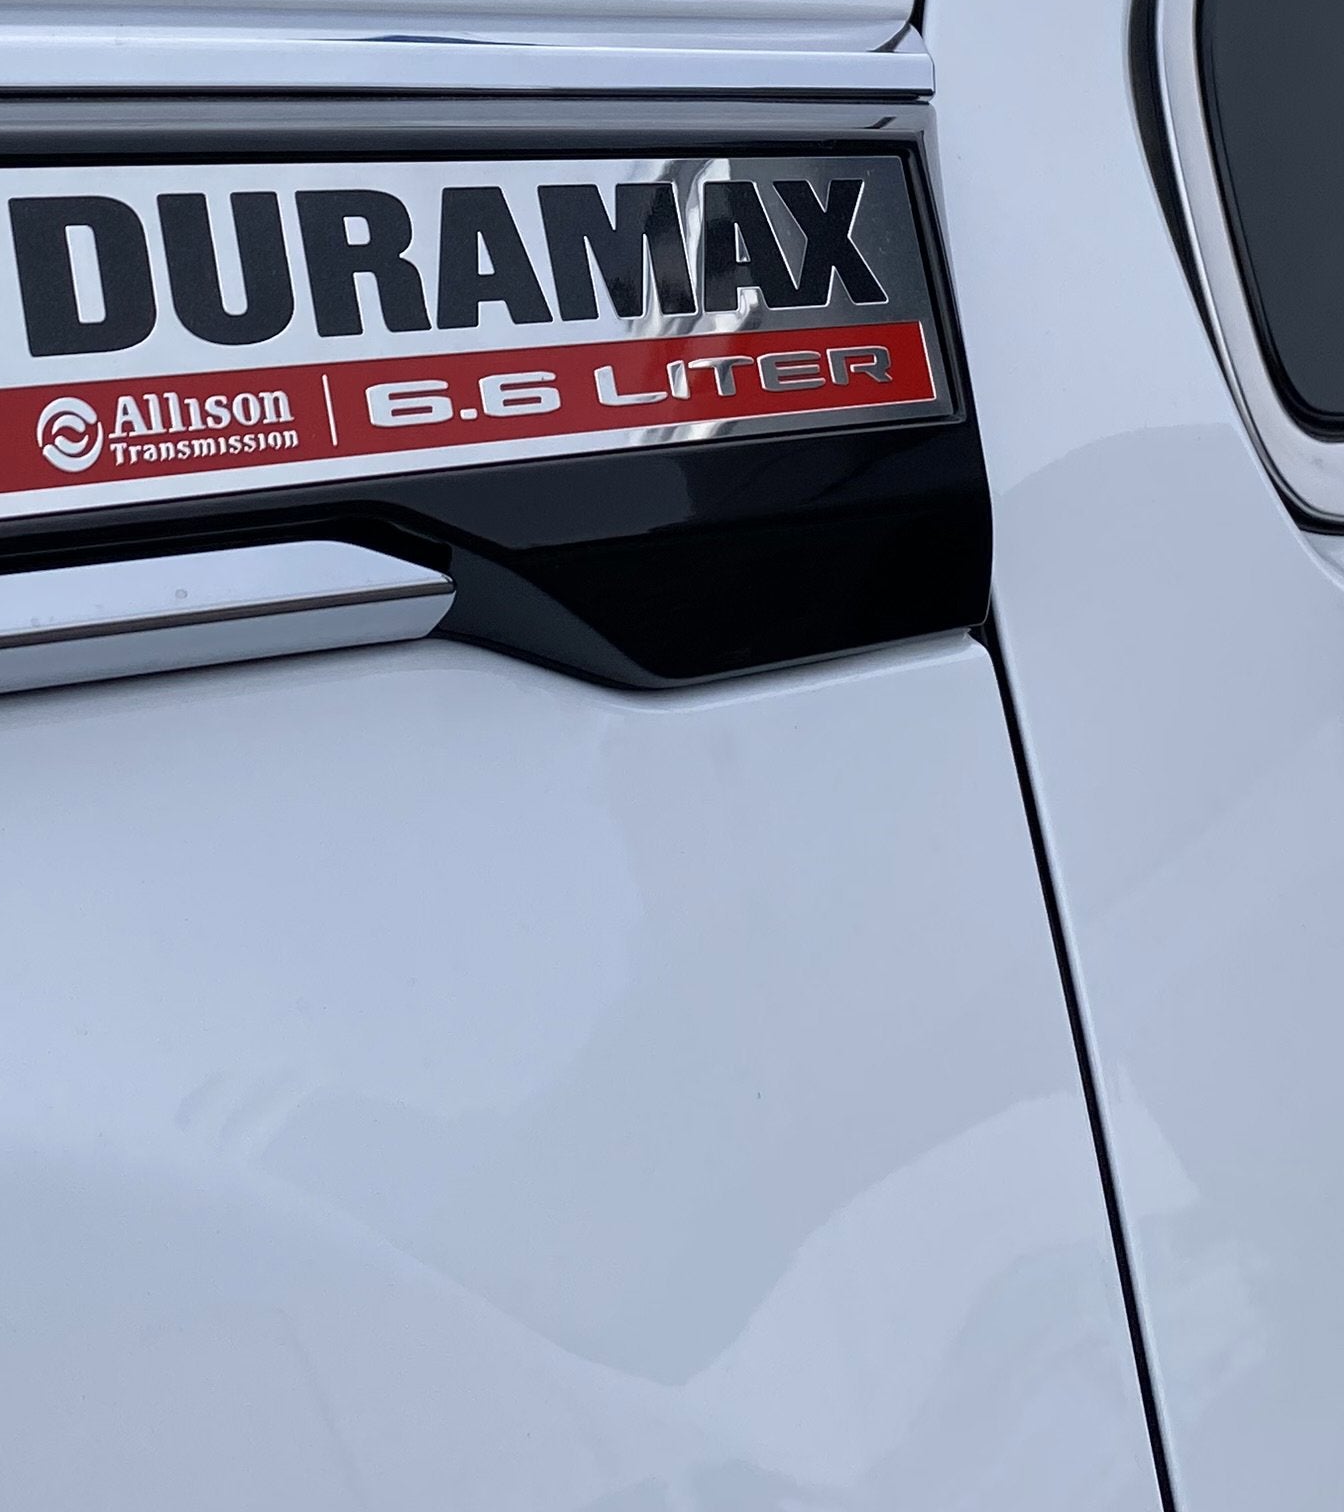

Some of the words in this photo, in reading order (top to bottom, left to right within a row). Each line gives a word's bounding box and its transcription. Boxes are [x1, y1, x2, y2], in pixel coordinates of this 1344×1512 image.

[8, 179, 889, 358] DURAMAX
[108, 389, 295, 439] Allison
[365, 371, 561, 427] 6.6
[594, 346, 894, 407] LITER
[110, 428, 299, 466] Transmission
